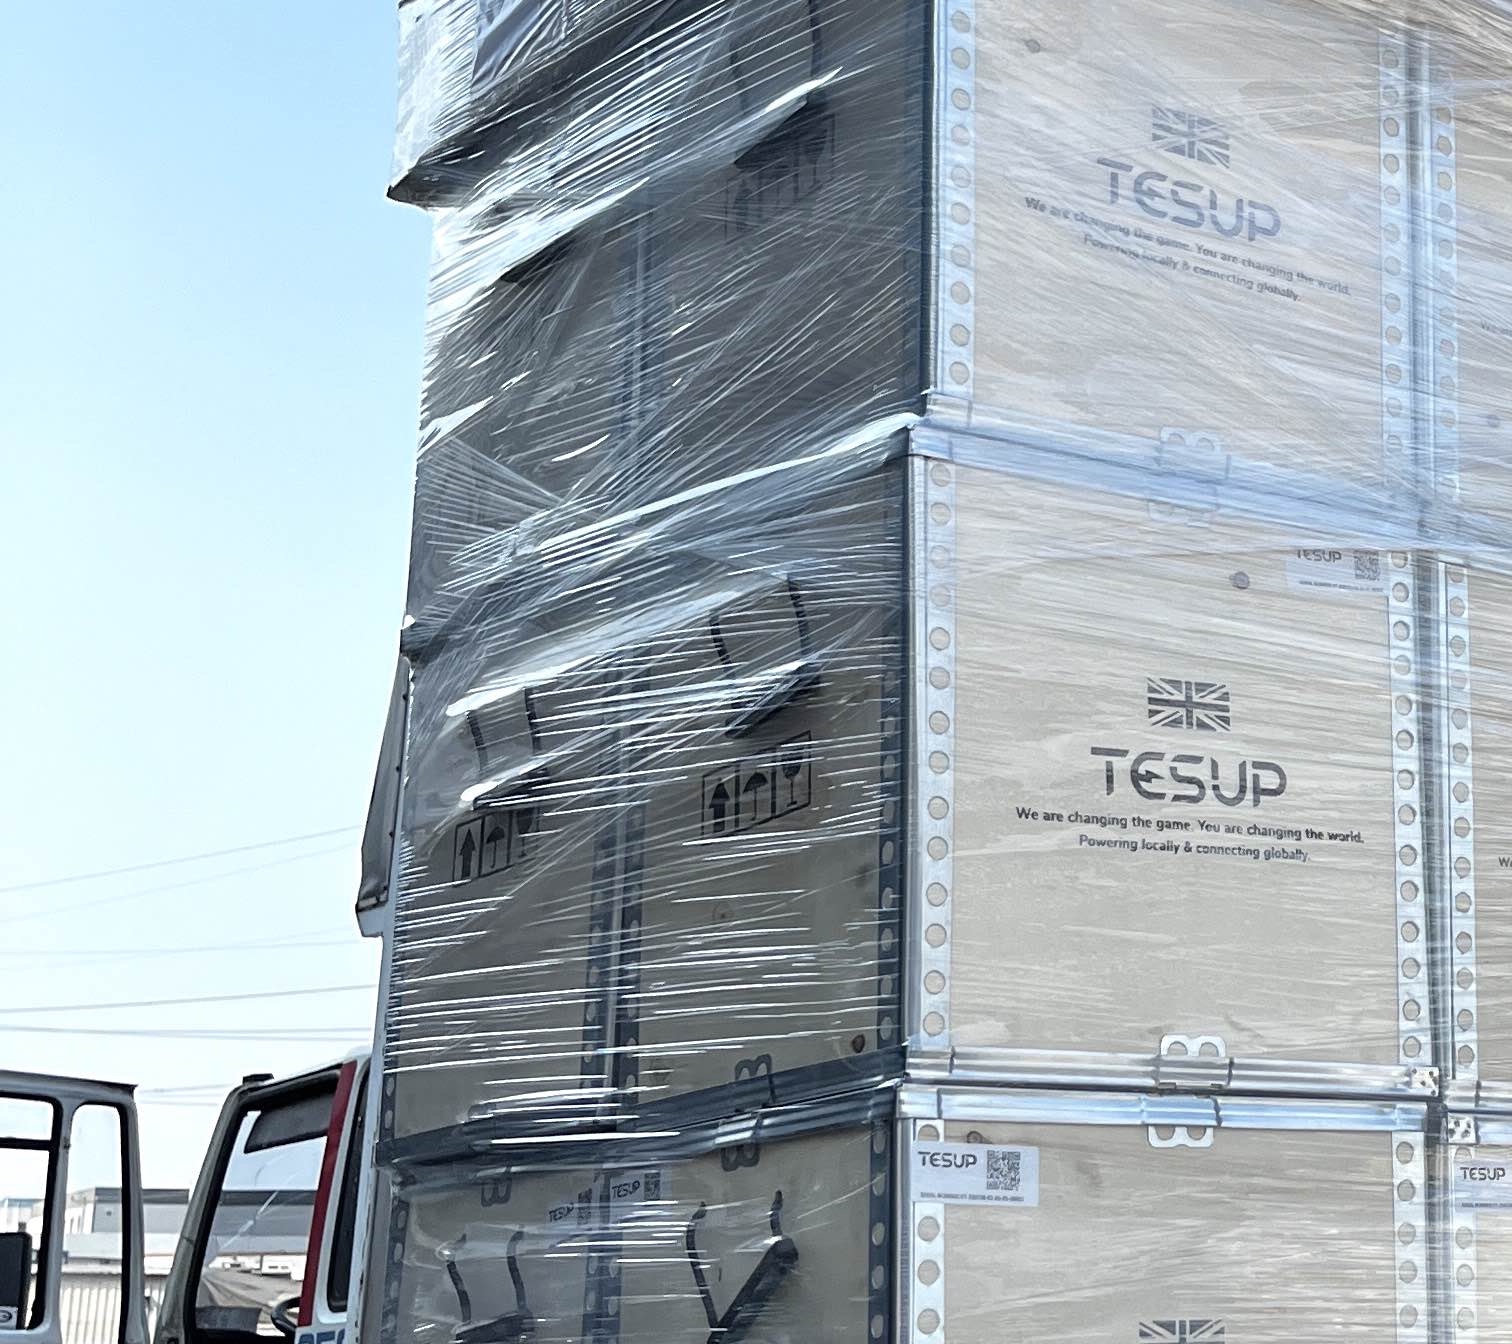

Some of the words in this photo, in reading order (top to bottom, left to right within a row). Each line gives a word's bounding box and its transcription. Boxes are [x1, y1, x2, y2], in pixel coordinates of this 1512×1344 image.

[1097, 157, 1281, 242] TESUP
[1195, 243, 1217, 258] You
[1221, 252, 1238, 264] are
[1297, 549, 1342, 563] TESUP
[1090, 746, 1287, 807] TESUP
[1016, 807, 1038, 820] We
[1043, 811, 1063, 822] are
[1068, 811, 1127, 828] changing
[1132, 816, 1152, 828] the
[1198, 819, 1220, 833] You
[1224, 824, 1243, 834] are
[1247, 824, 1302, 841] changing
[1305, 829, 1324, 840] the
[1328, 830, 1365, 844] world.
[1079, 834, 1137, 851] Powering
[1142, 839, 1180, 854] locally
[1184, 841, 1192, 853] &
[1196, 844, 1260, 860] connecting
[918, 1152, 977, 1168] TESUP
[1460, 1167, 1505, 1181] TESUP
